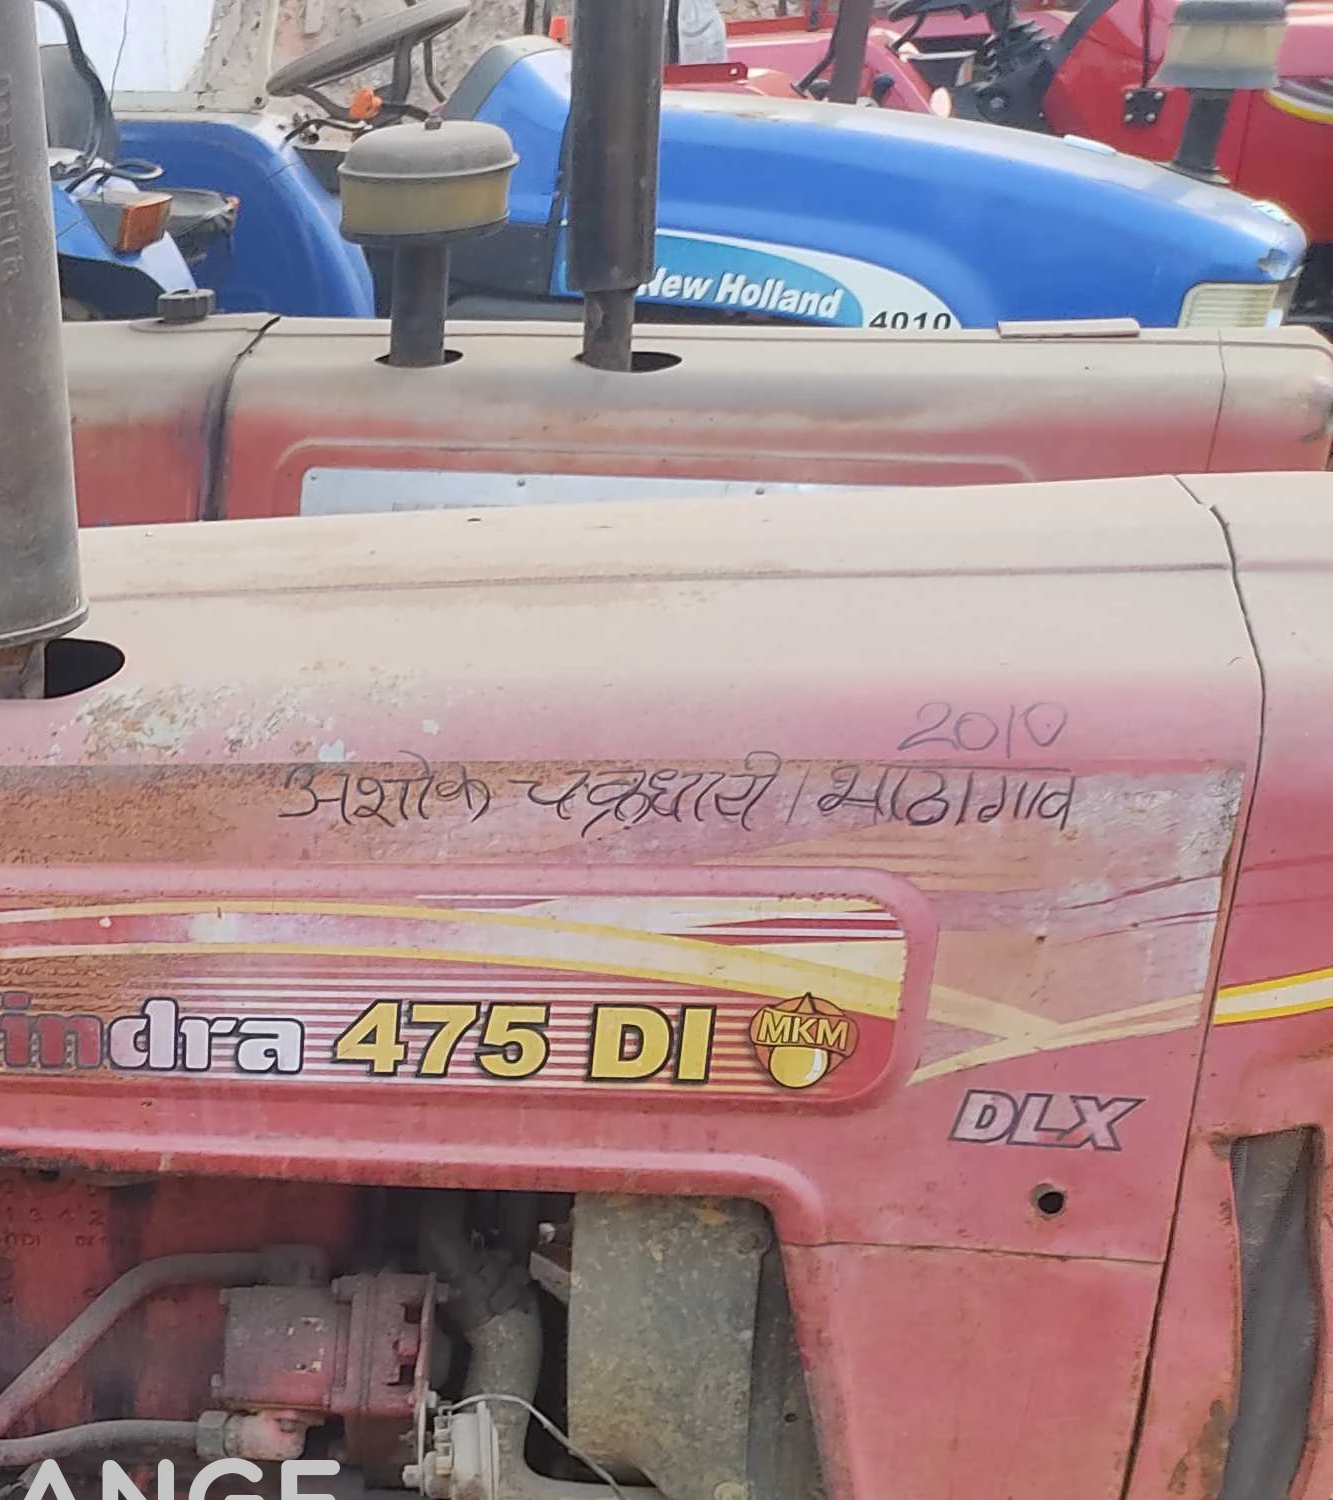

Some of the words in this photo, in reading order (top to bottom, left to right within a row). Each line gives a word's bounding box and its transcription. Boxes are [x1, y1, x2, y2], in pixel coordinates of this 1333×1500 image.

[635, 268, 714, 301] New
[715, 273, 845, 320] Holland
[869, 311, 952, 330] 4010
[898, 702, 1068, 760] 2010
[278, 749, 491, 828] अशोक
[332, 999, 551, 1081] 475
[587, 1003, 718, 1083] DI
[757, 1008, 851, 1052] MKM
[948, 1089, 1147, 1151] DLX
